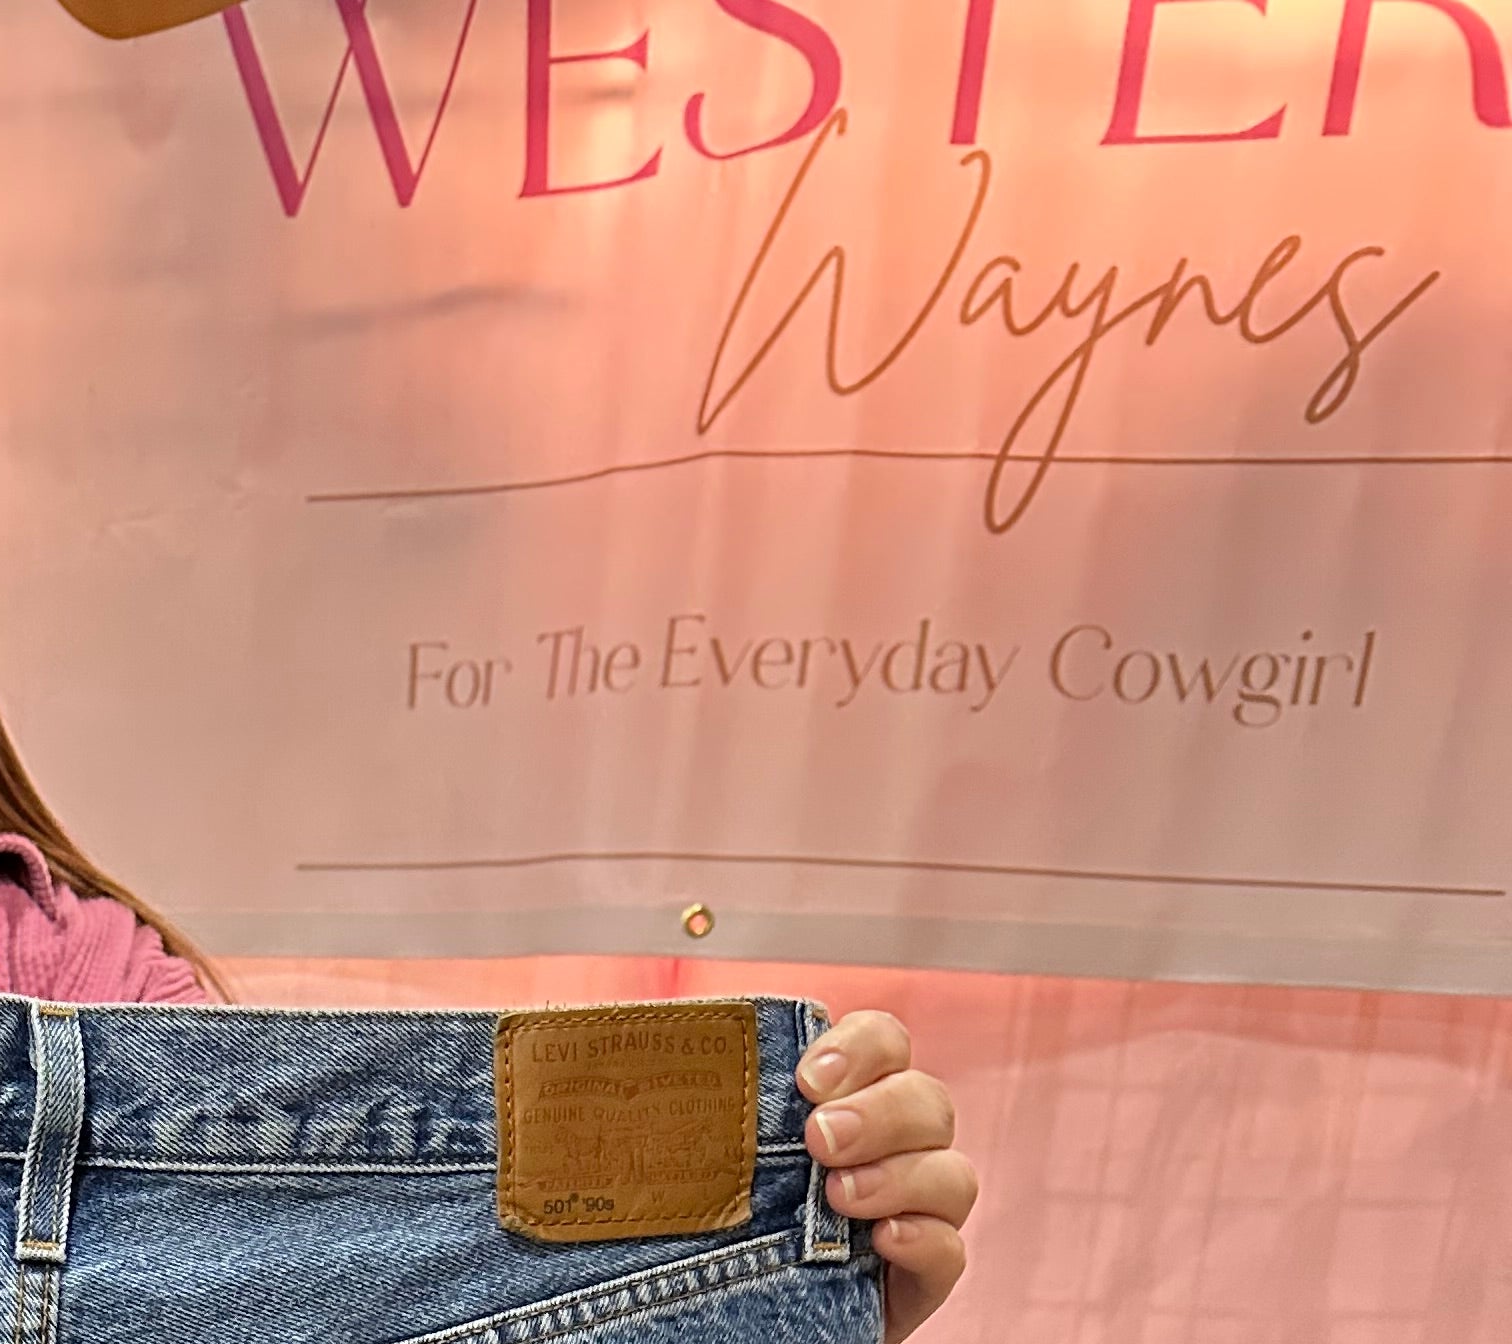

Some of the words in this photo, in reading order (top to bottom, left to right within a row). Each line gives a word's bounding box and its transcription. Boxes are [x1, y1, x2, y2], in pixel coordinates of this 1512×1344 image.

[696, 106, 1440, 533] Waynes
[407, 640, 513, 710] For
[536, 624, 642, 701] The
[660, 613, 1021, 713] Everyday
[1048, 623, 1377, 729] Cowgirl
[532, 1042, 578, 1063] LEVI
[587, 1031, 676, 1059] STRAUSS
[681, 1038, 694, 1055] &
[523, 1105, 586, 1125] GENUINE
[592, 1103, 662, 1124] QUALITY
[668, 1095, 736, 1117] CLOTHING
